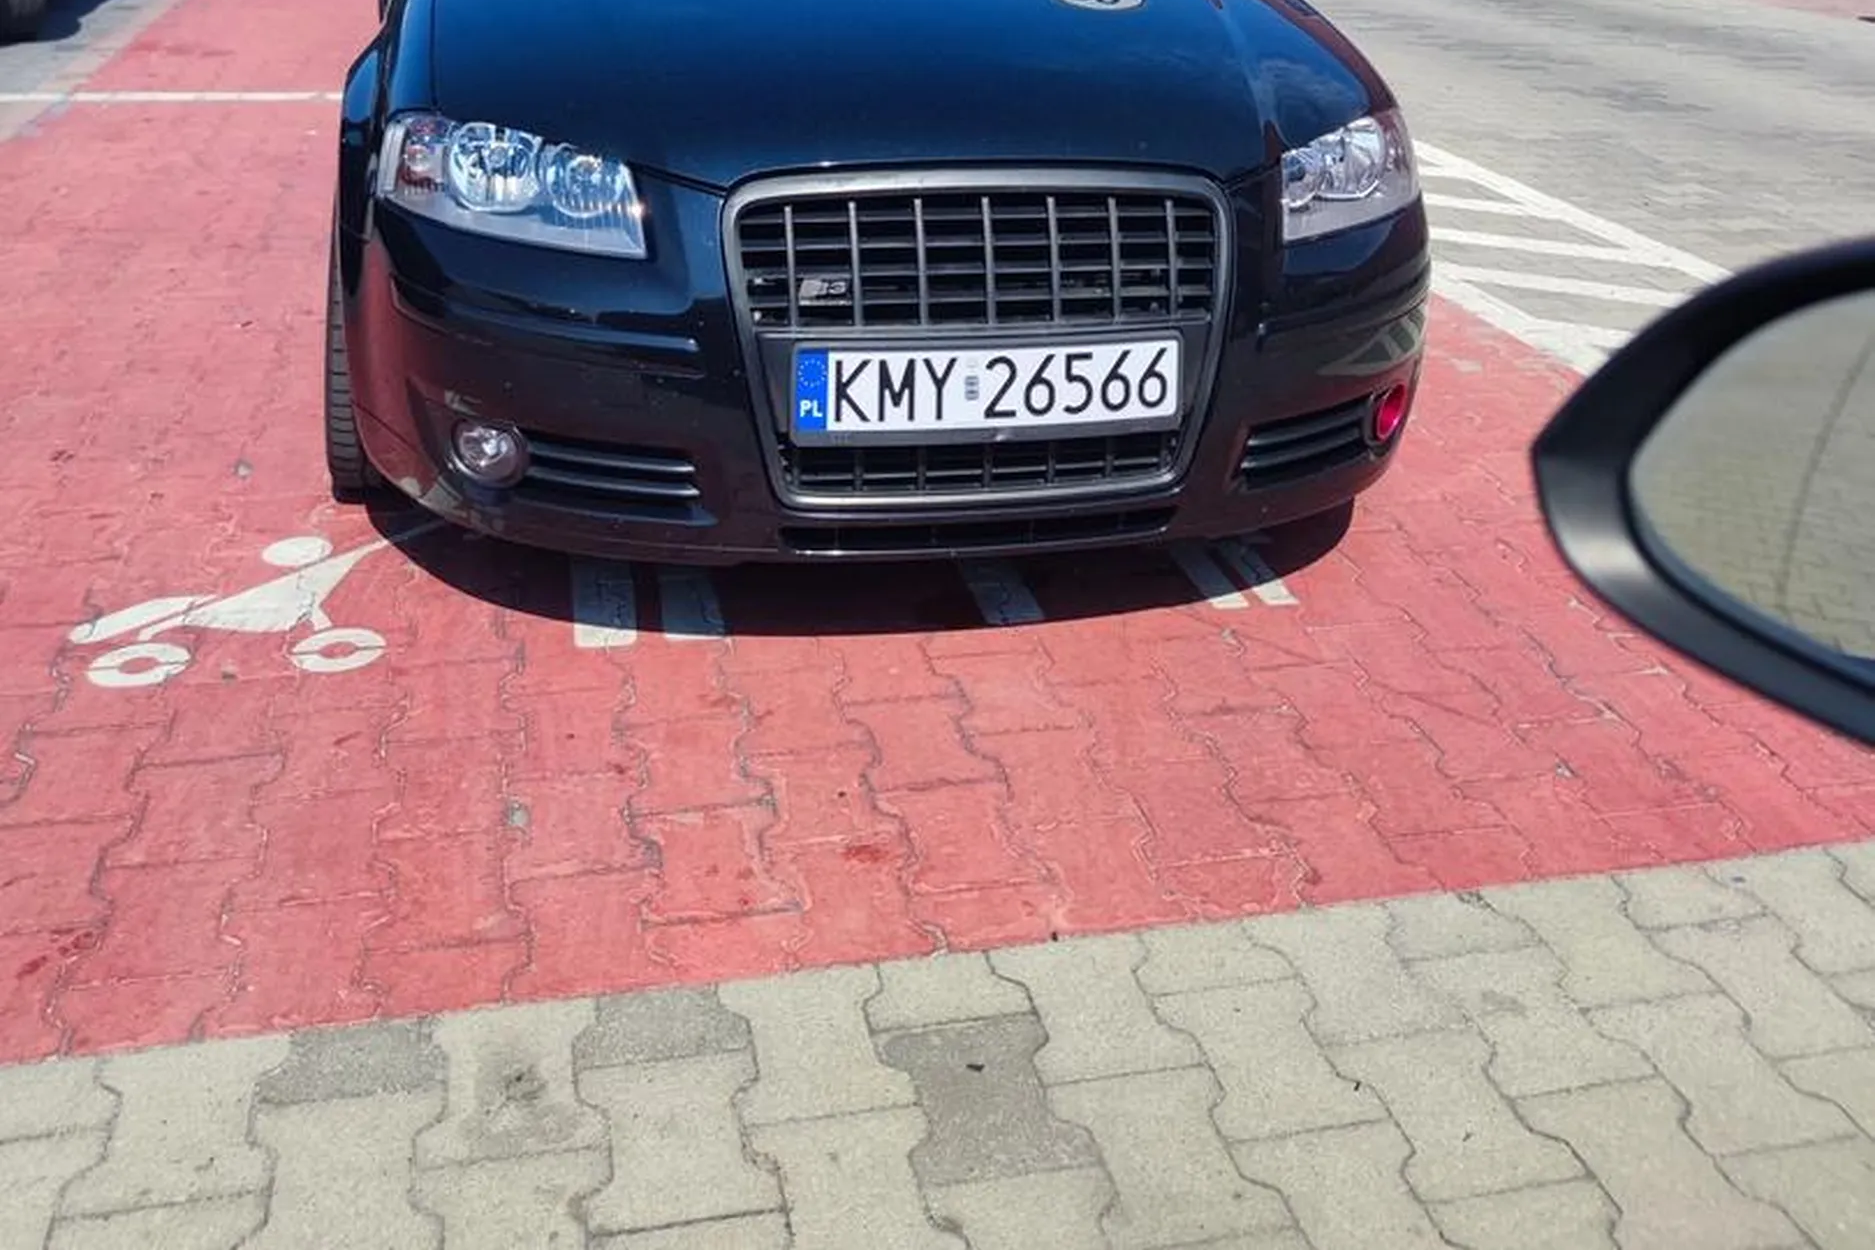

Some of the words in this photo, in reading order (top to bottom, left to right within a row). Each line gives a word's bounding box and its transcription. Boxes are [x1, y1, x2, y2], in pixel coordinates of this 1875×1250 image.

[833, 356, 958, 423] KMY
[982, 347, 1169, 421] 26566
[799, 400, 824, 419] PL
